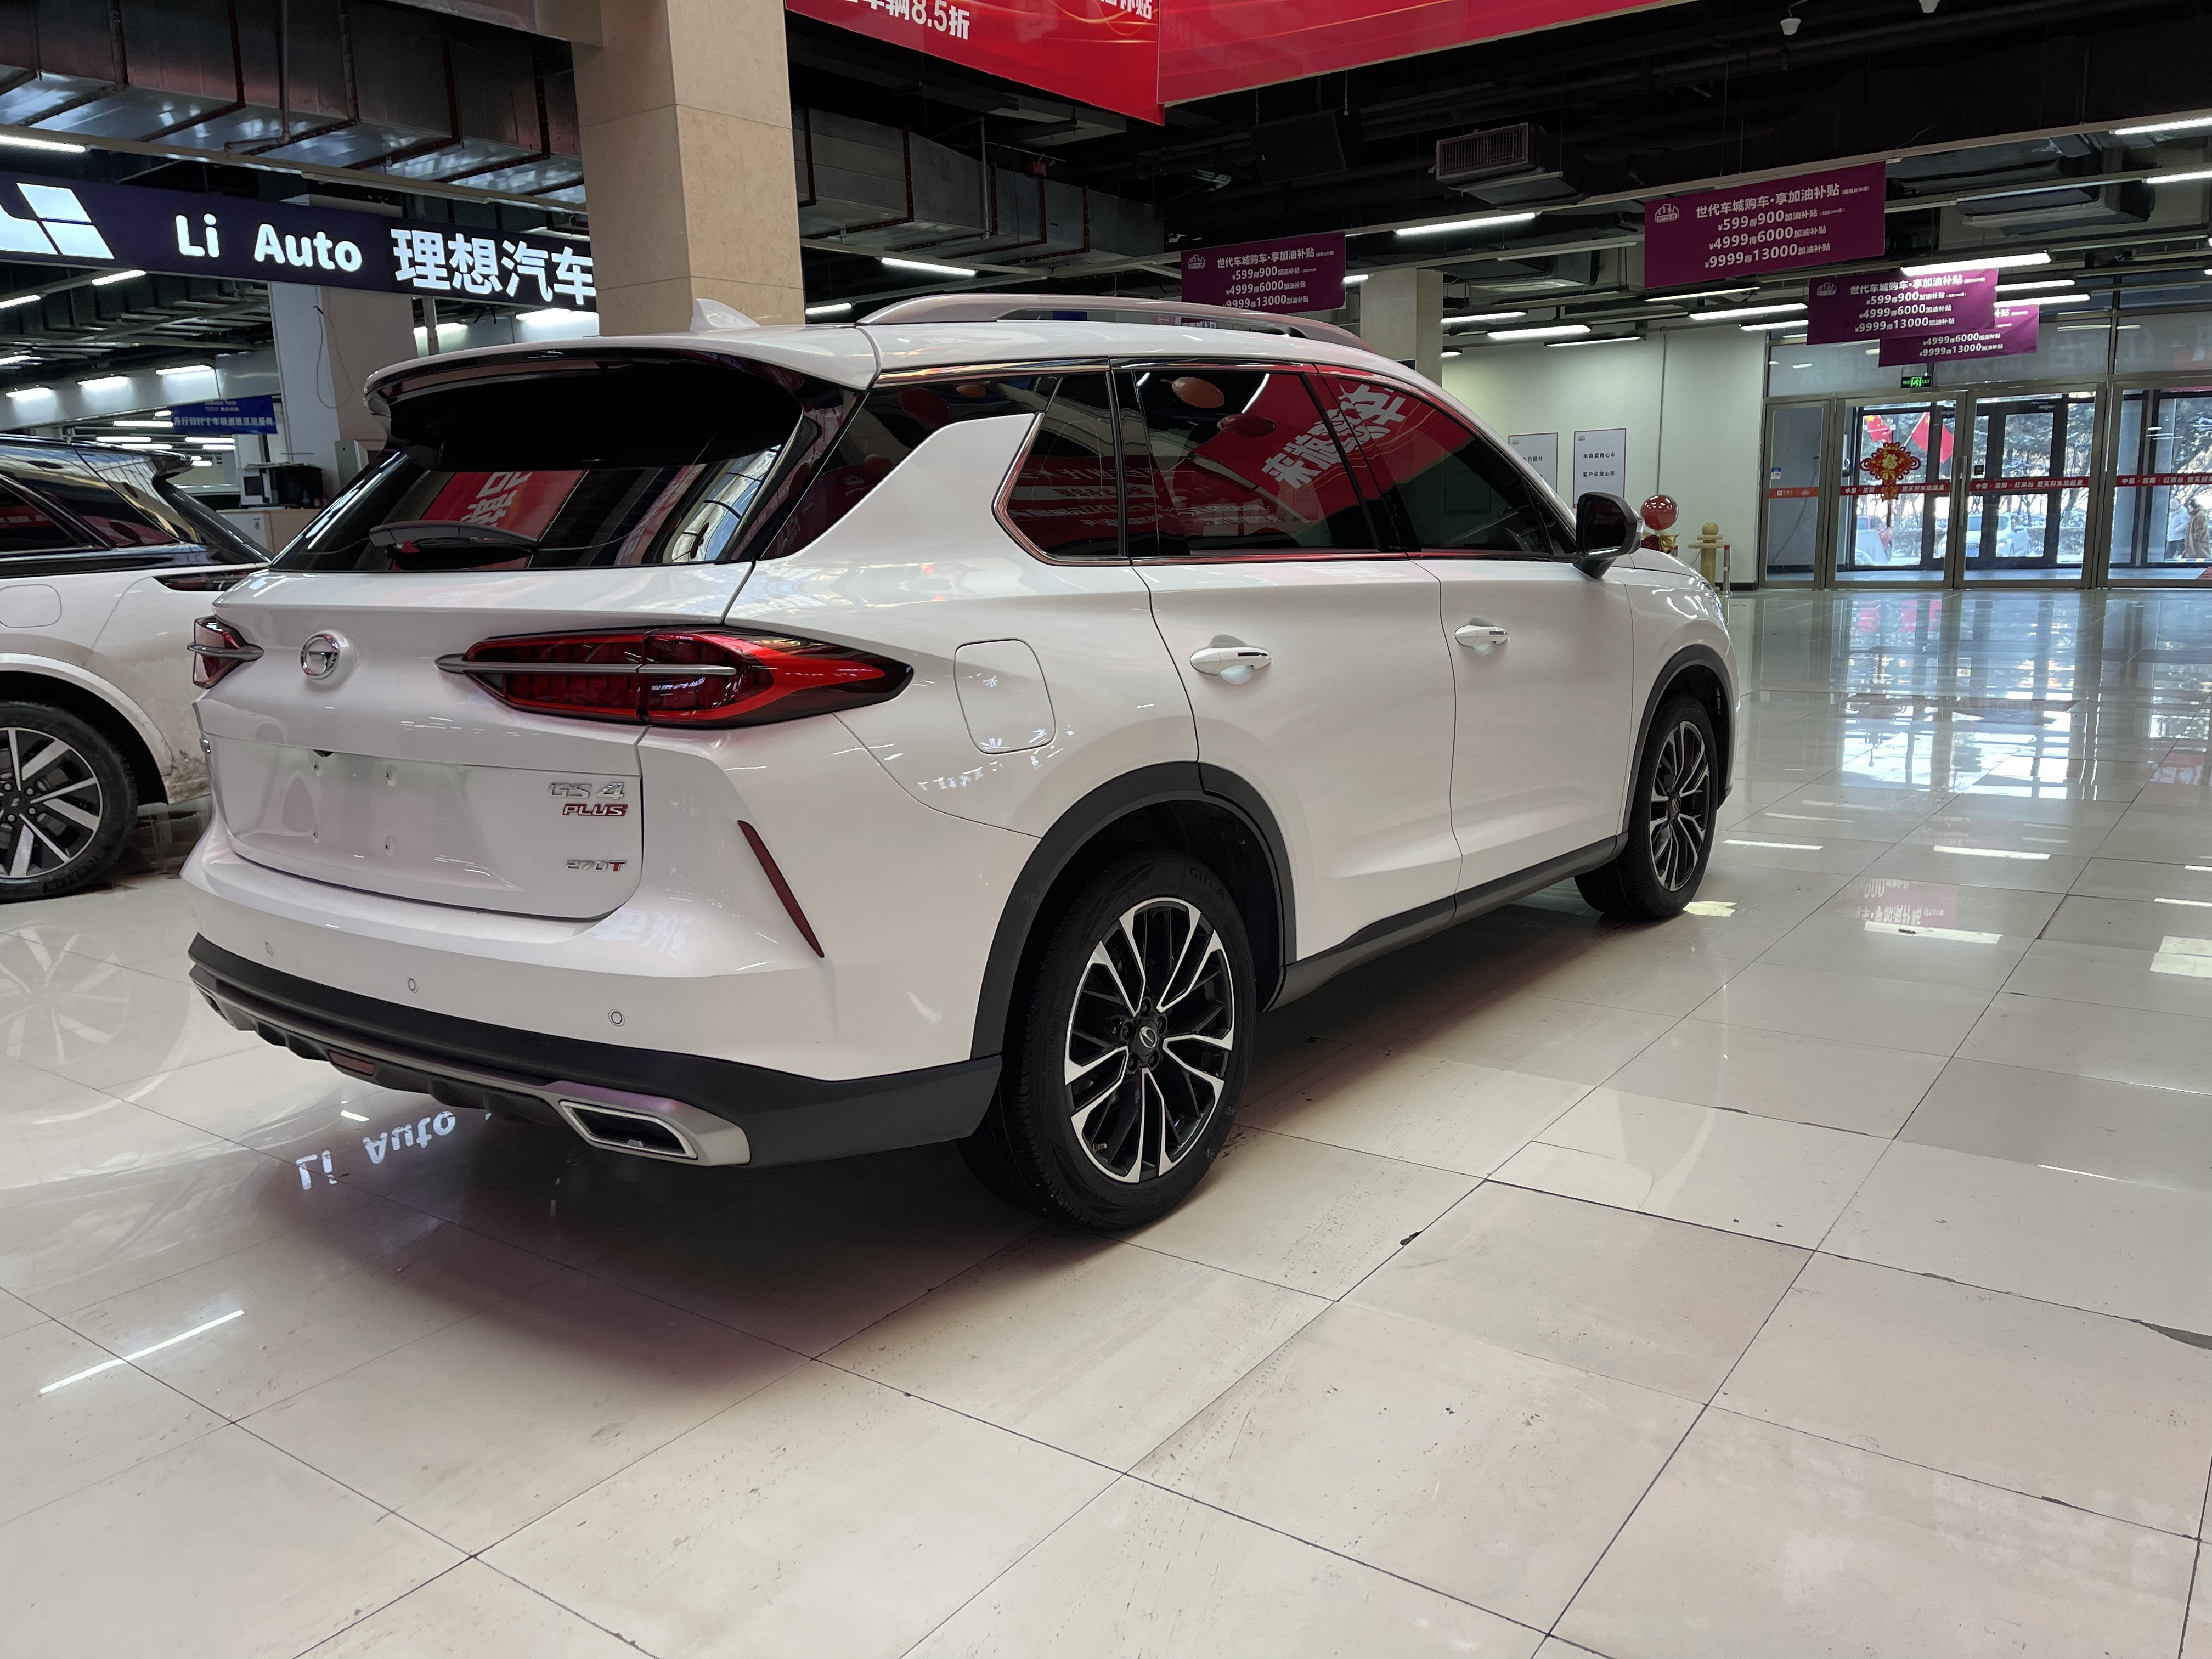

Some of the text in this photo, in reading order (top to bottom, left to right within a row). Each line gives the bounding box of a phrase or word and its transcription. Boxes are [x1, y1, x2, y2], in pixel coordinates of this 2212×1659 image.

[1696, 183, 1840, 219] 世代车城购车·享加油补贴
[175, 213, 363, 272] Li Auto
[1709, 225, 1827, 250] ¥4999得6000加油补贴
[390, 228, 597, 306] 理想汽车
[1705, 242, 1831, 268] ¥9999得13000加油补贴
[1223, 295, 1309, 308] 9999得13000加油补贴
[562, 804, 628, 816] PLUS
[566, 859, 627, 872] 270T
